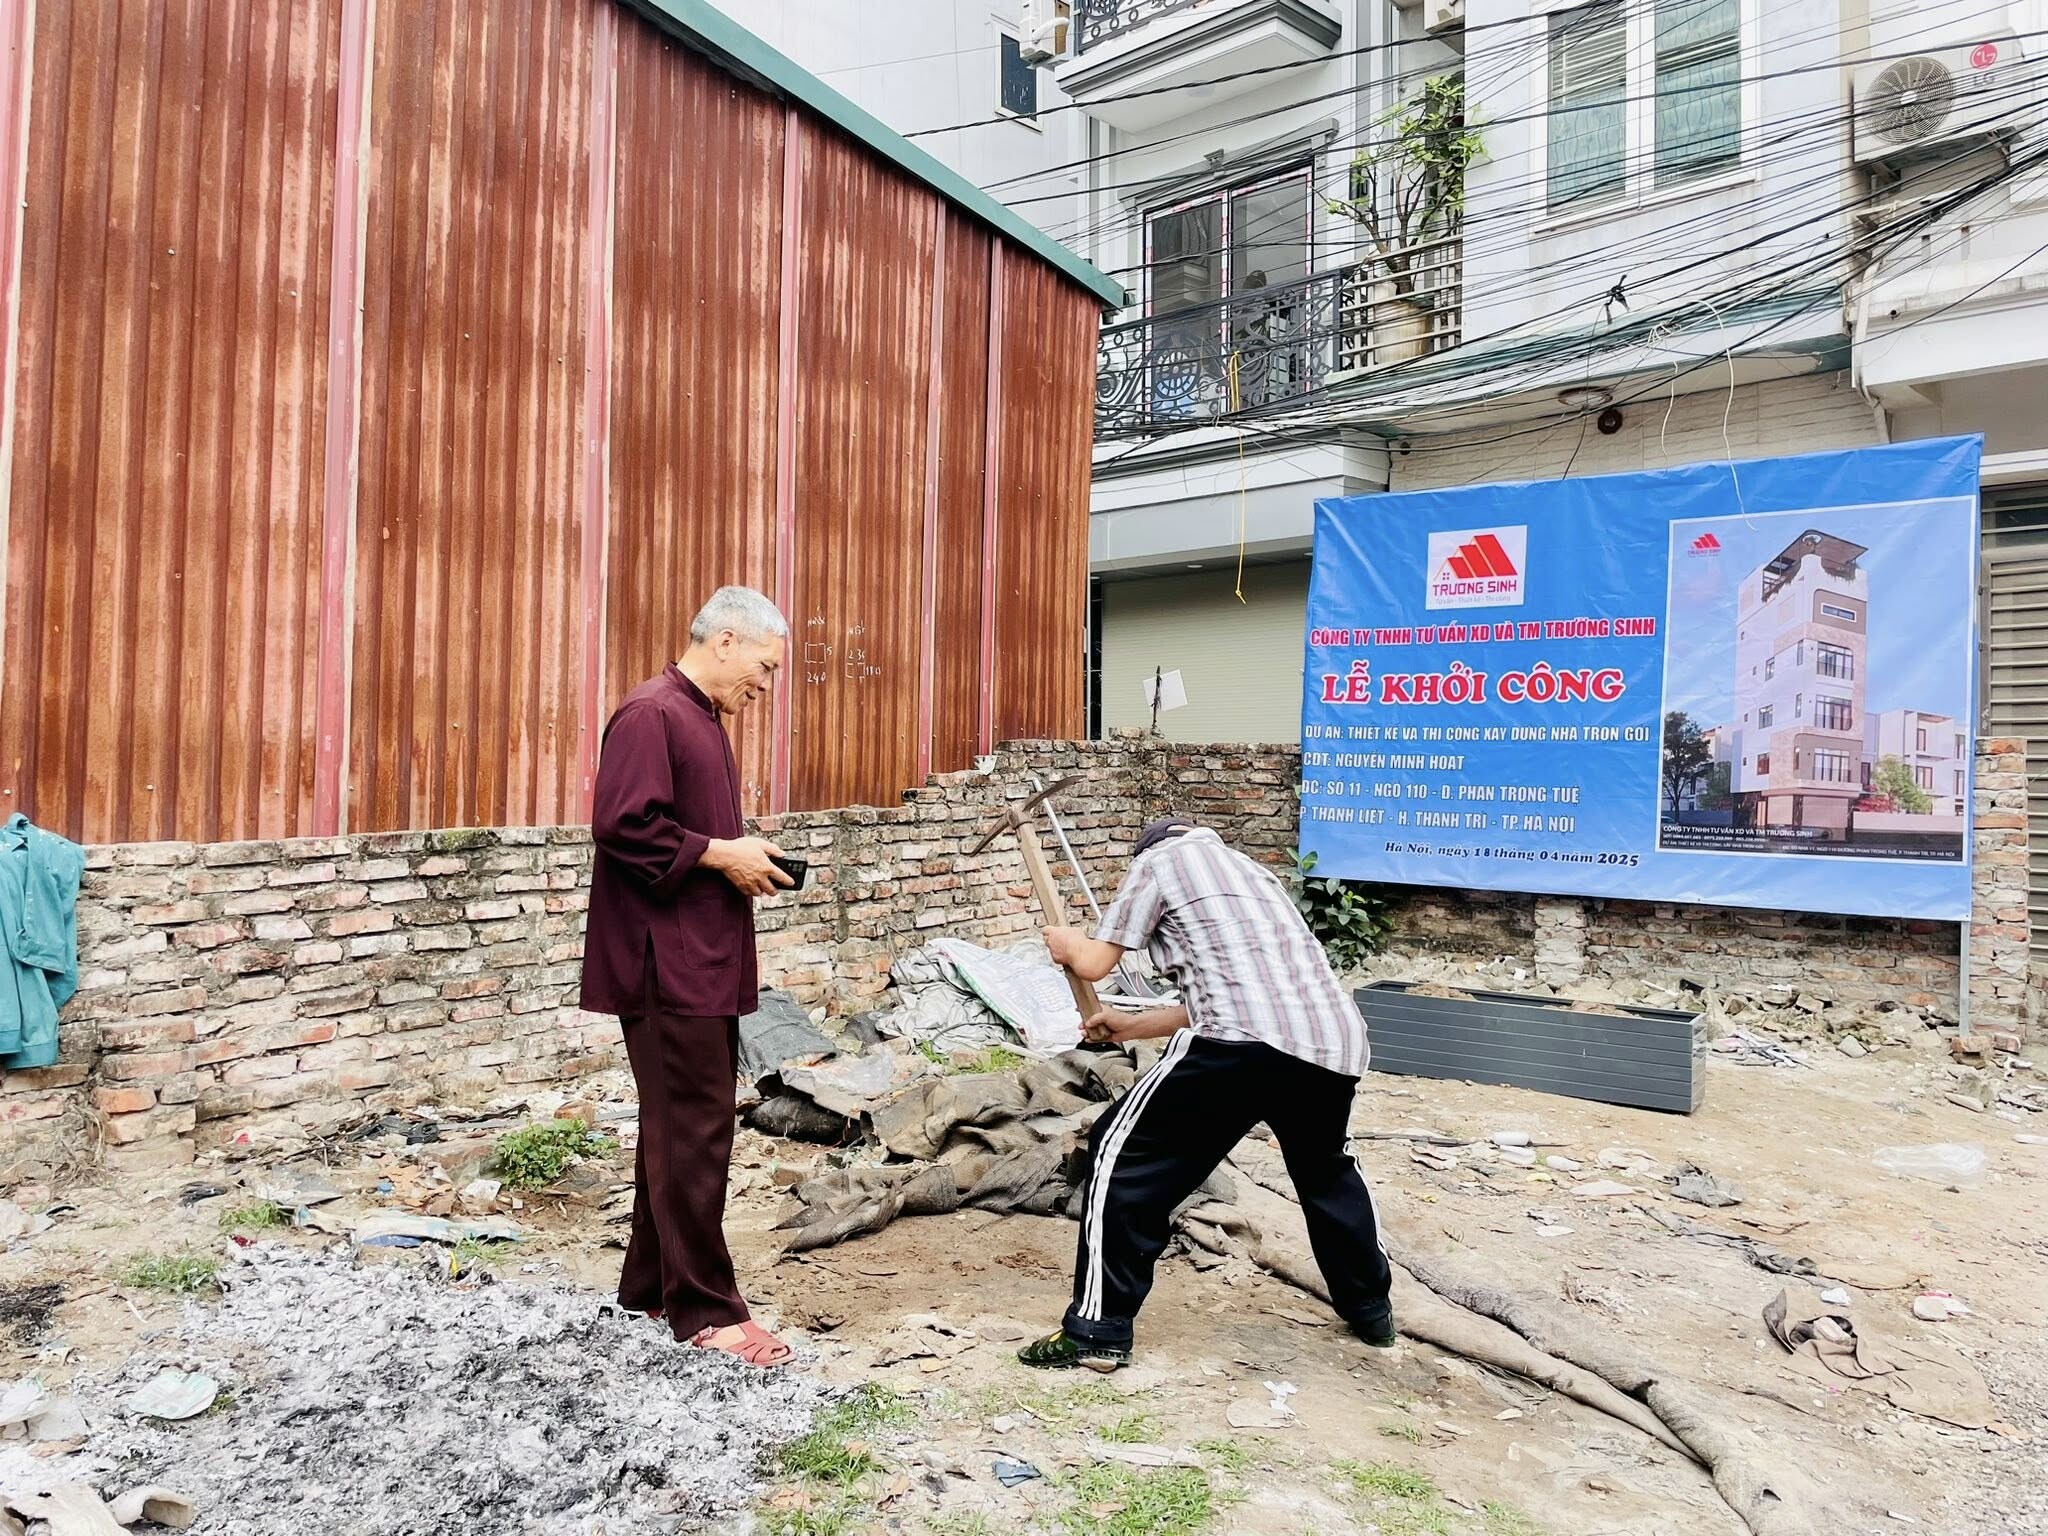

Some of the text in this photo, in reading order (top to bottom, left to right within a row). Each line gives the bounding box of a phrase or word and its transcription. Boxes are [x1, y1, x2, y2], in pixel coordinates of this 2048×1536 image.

[1488, 580, 1517, 593] SINH
[1311, 617, 1655, 646] CÔNG TY TNHH TƯ VẤN XD VÀ TM TRƯỜNG SINH
[1321, 660, 1626, 703] LỄ KHỞI CÔNG
[1422, 727, 1441, 740] THI
[1390, 755, 1424, 769] MINH
[1349, 782, 1361, 796] 11
[1406, 784, 1428, 798] 110
[1459, 785, 1495, 801] PHAN
[1311, 806, 1354, 822] THANH
[1398, 811, 1410, 826] H.
[1416, 811, 1460, 828] THANH
[1501, 814, 1519, 830] TP.
[1385, 841, 1402, 852] Hà
[1438, 844, 1470, 858] ngày
[1597, 853, 1639, 867] 2025
